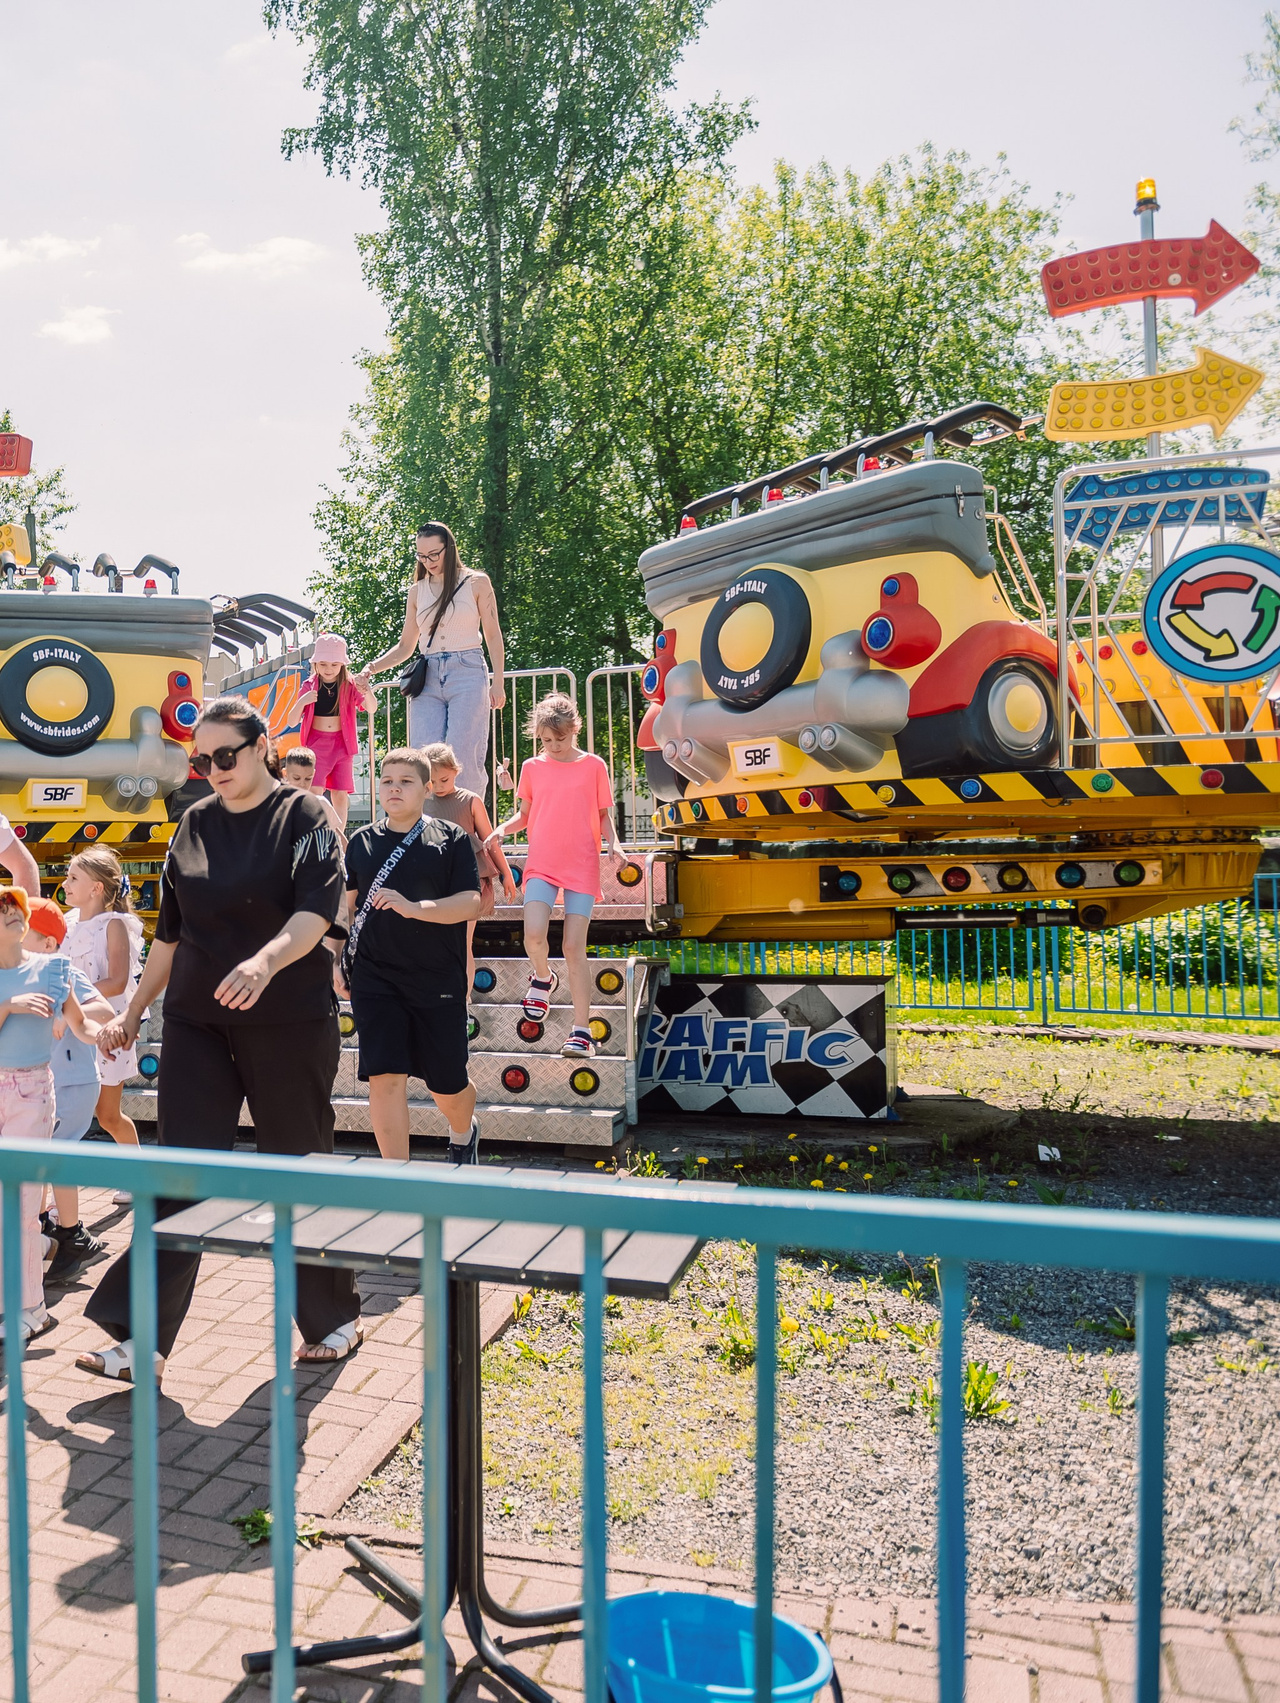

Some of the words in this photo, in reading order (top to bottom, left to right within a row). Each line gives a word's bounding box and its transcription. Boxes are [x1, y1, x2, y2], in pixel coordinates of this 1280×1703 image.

[20, 712, 100, 737] www.sbfrides.com
[745, 748, 771, 767] SBF
[42, 787, 75, 802] SBF
